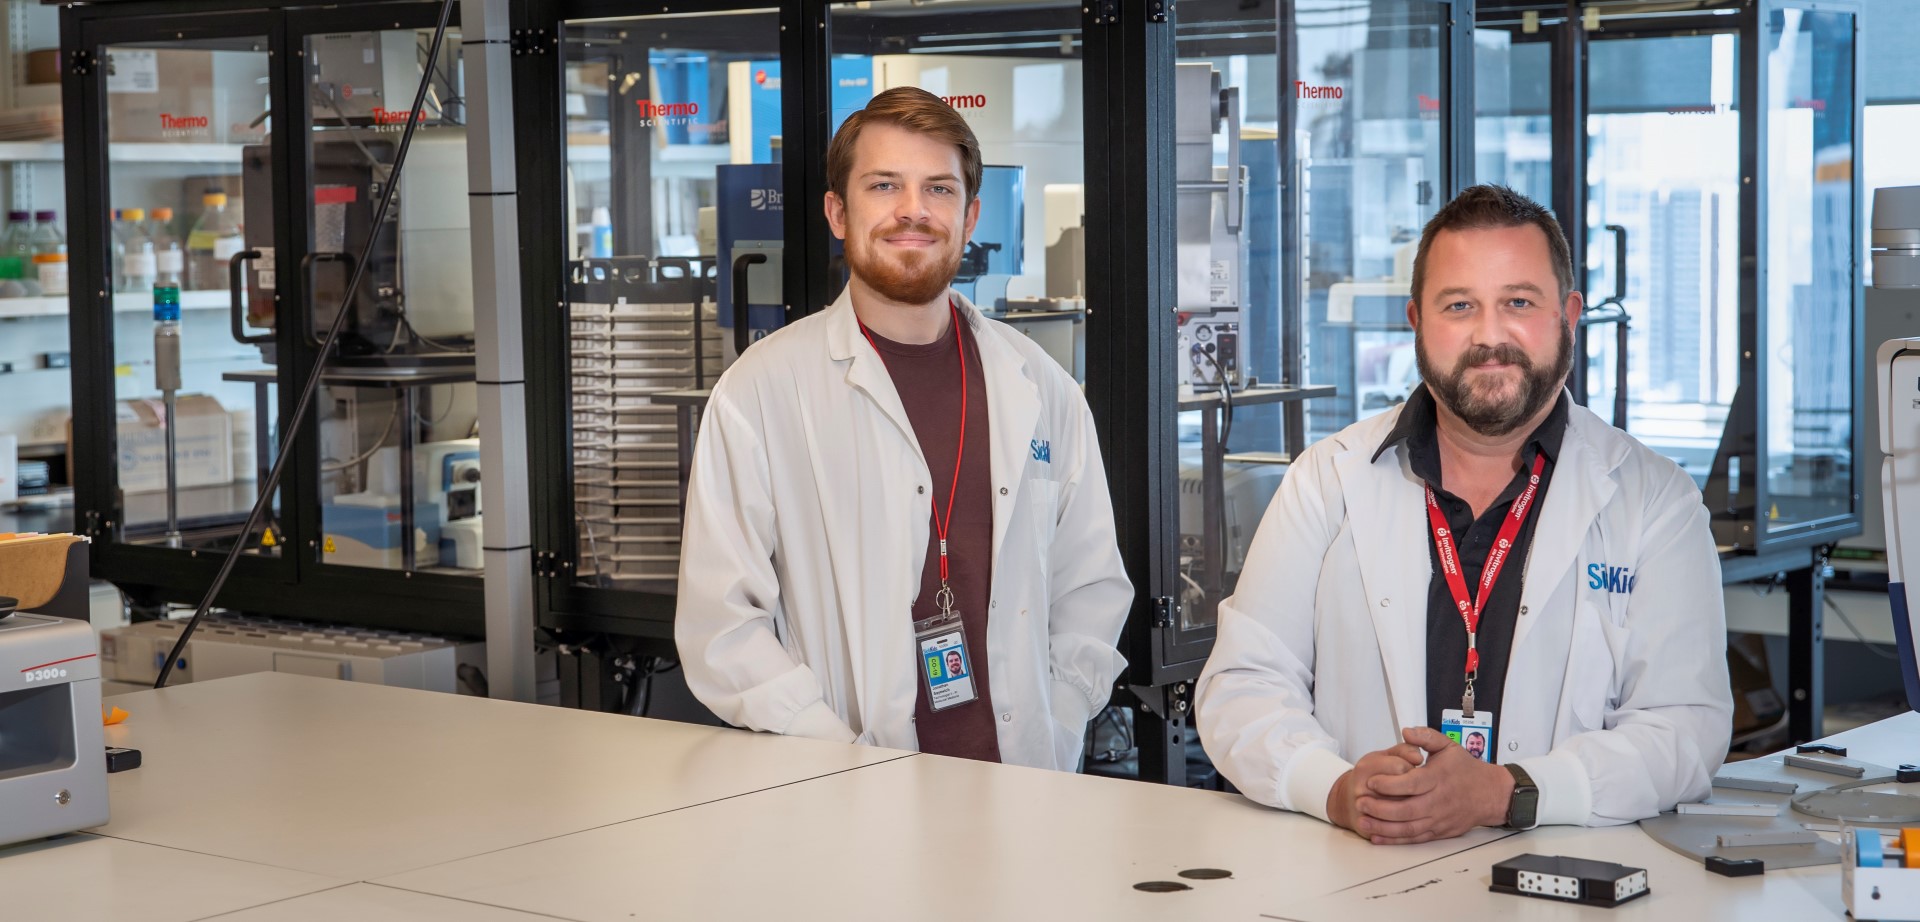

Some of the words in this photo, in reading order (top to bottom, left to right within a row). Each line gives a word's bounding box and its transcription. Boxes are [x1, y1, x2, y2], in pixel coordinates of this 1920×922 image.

[1293, 80, 1342, 99] Thermo
[636, 99, 699, 117] Thermo
[941, 94, 986, 108] ermo
[160, 113, 208, 129] Thermo
[375, 124, 426, 133] SCIENTIC
[639, 117, 698, 127] SCINTIFIC
[1442, 537, 1457, 575] Invitrogen
[1484, 550, 1505, 587] Invitrogen
[25, 668, 67, 683] D300e
